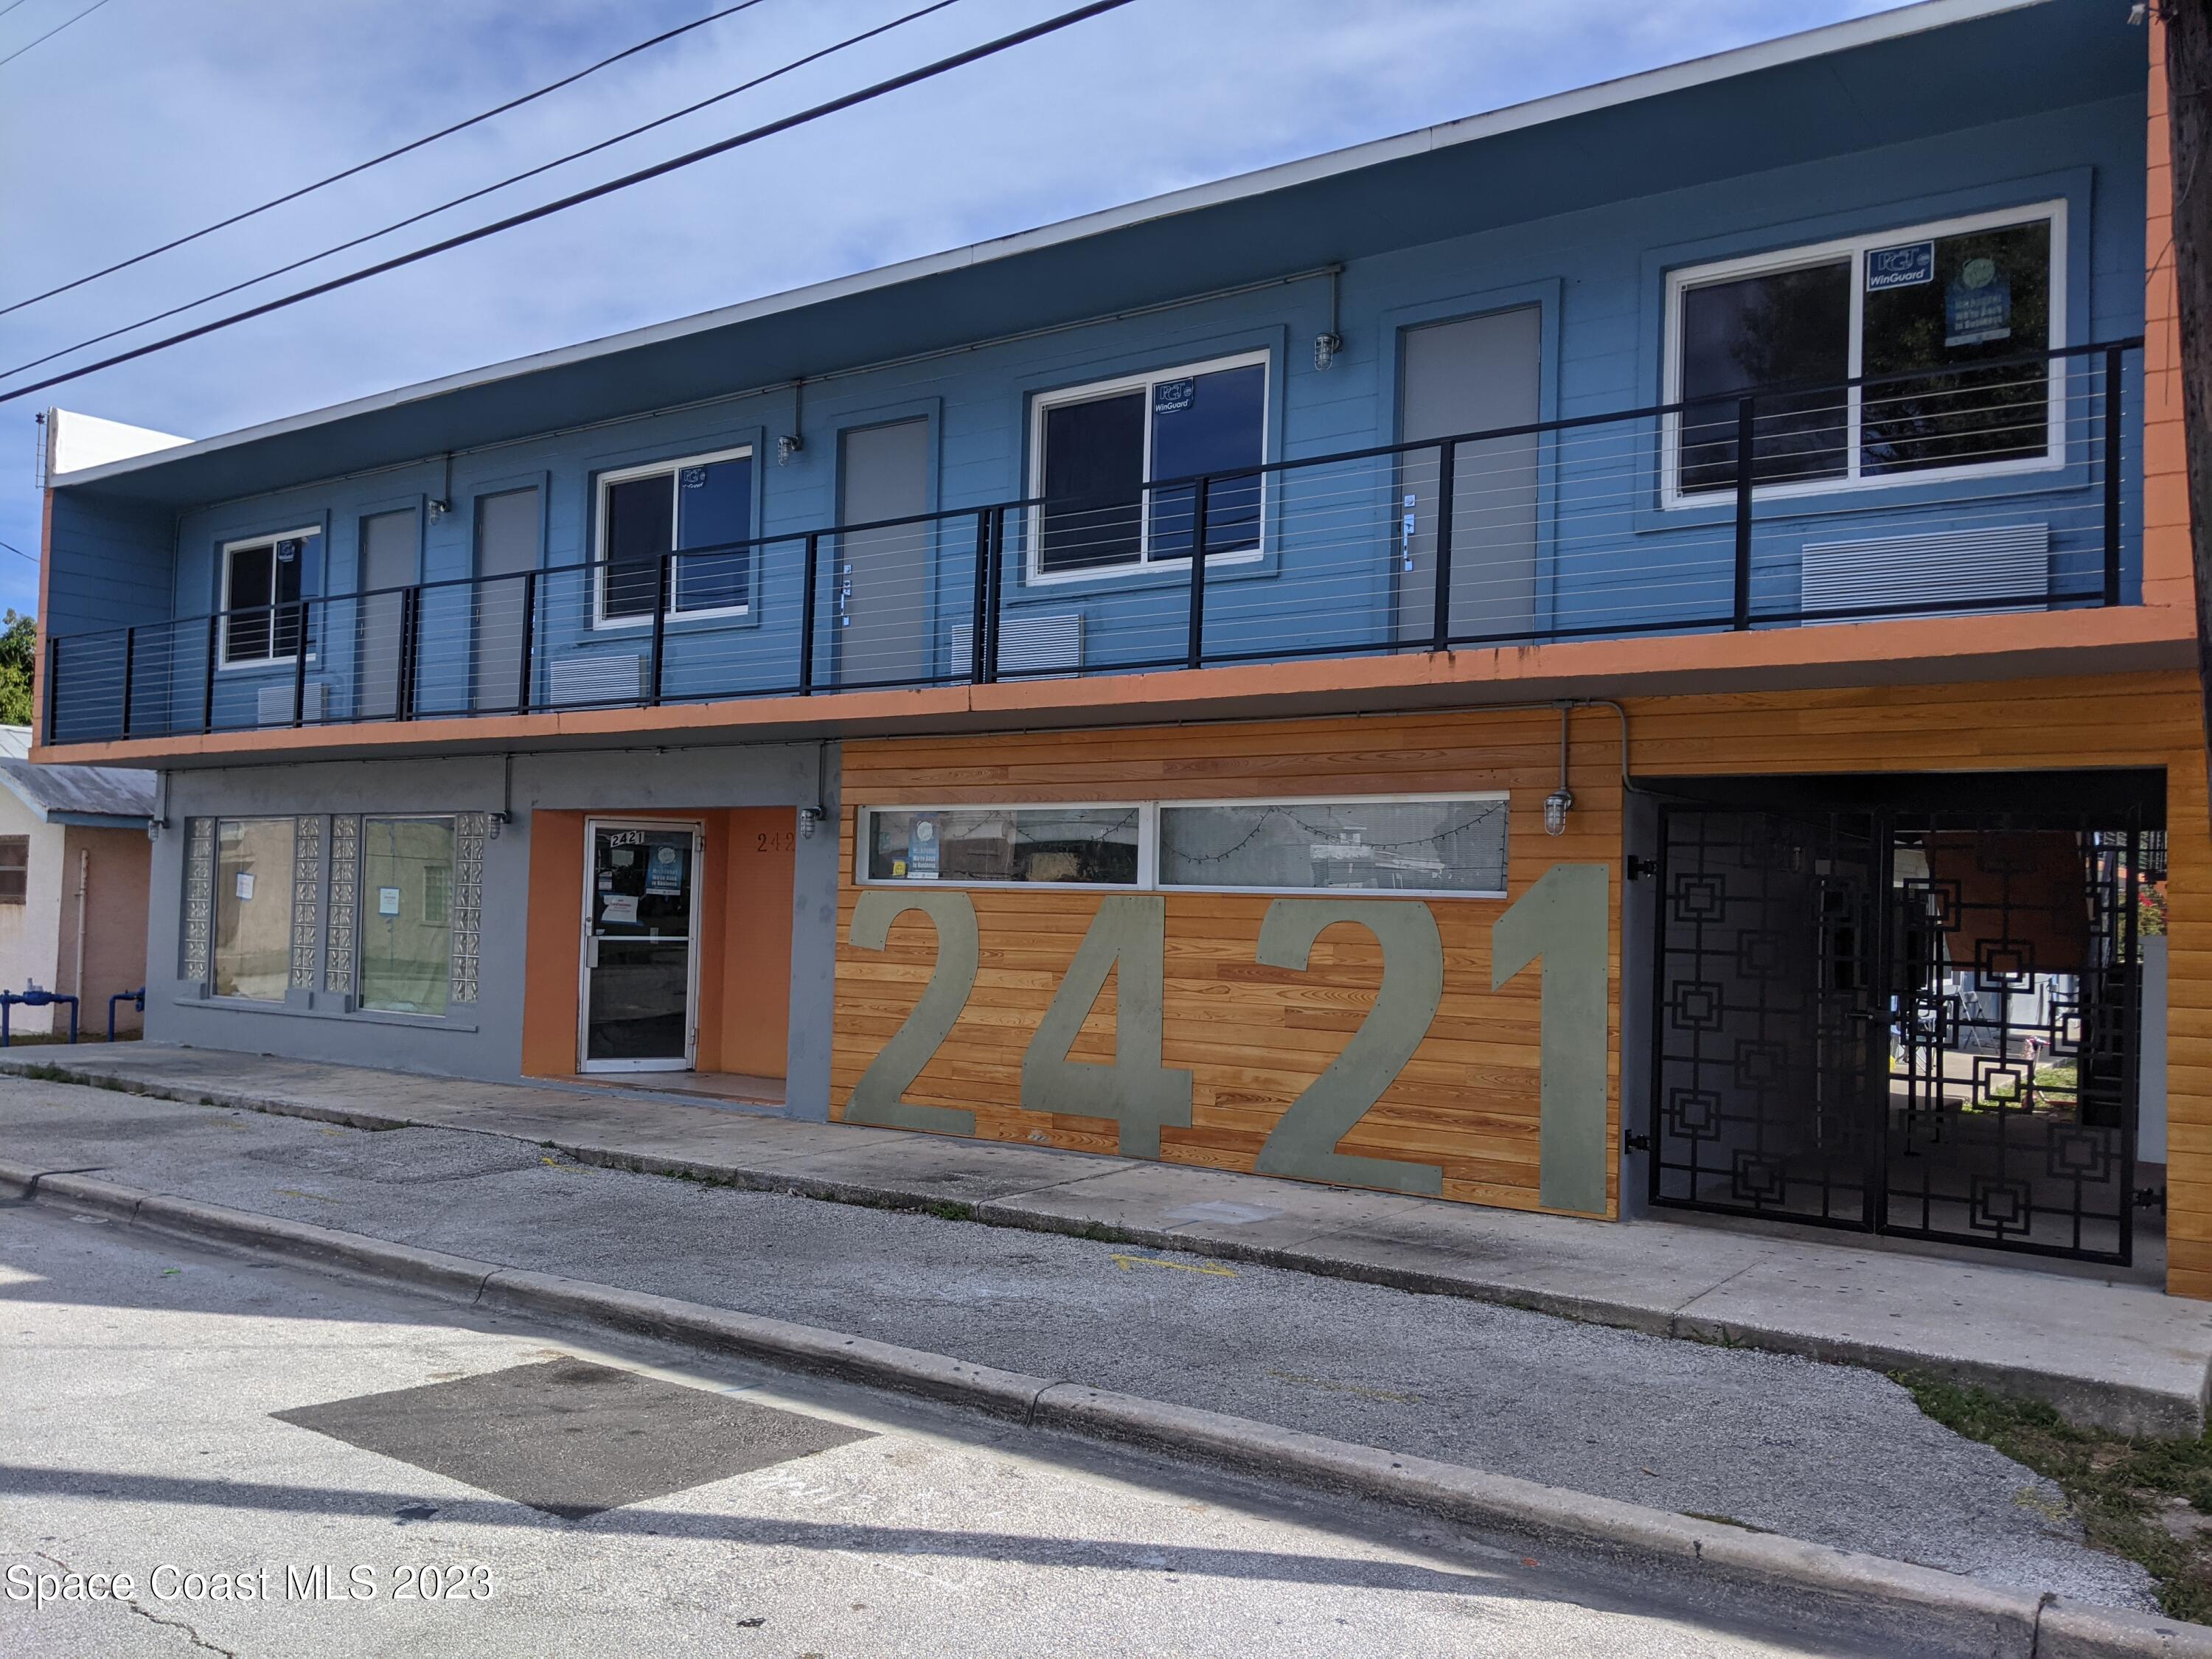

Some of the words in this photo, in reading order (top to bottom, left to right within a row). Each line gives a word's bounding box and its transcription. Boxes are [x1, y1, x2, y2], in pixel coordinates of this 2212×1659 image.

[1871, 268, 1925, 286] WinGuard
[1155, 399, 1189, 411] WinGuard
[612, 832, 642, 846] 2421
[843, 863, 1609, 1214] 2421
